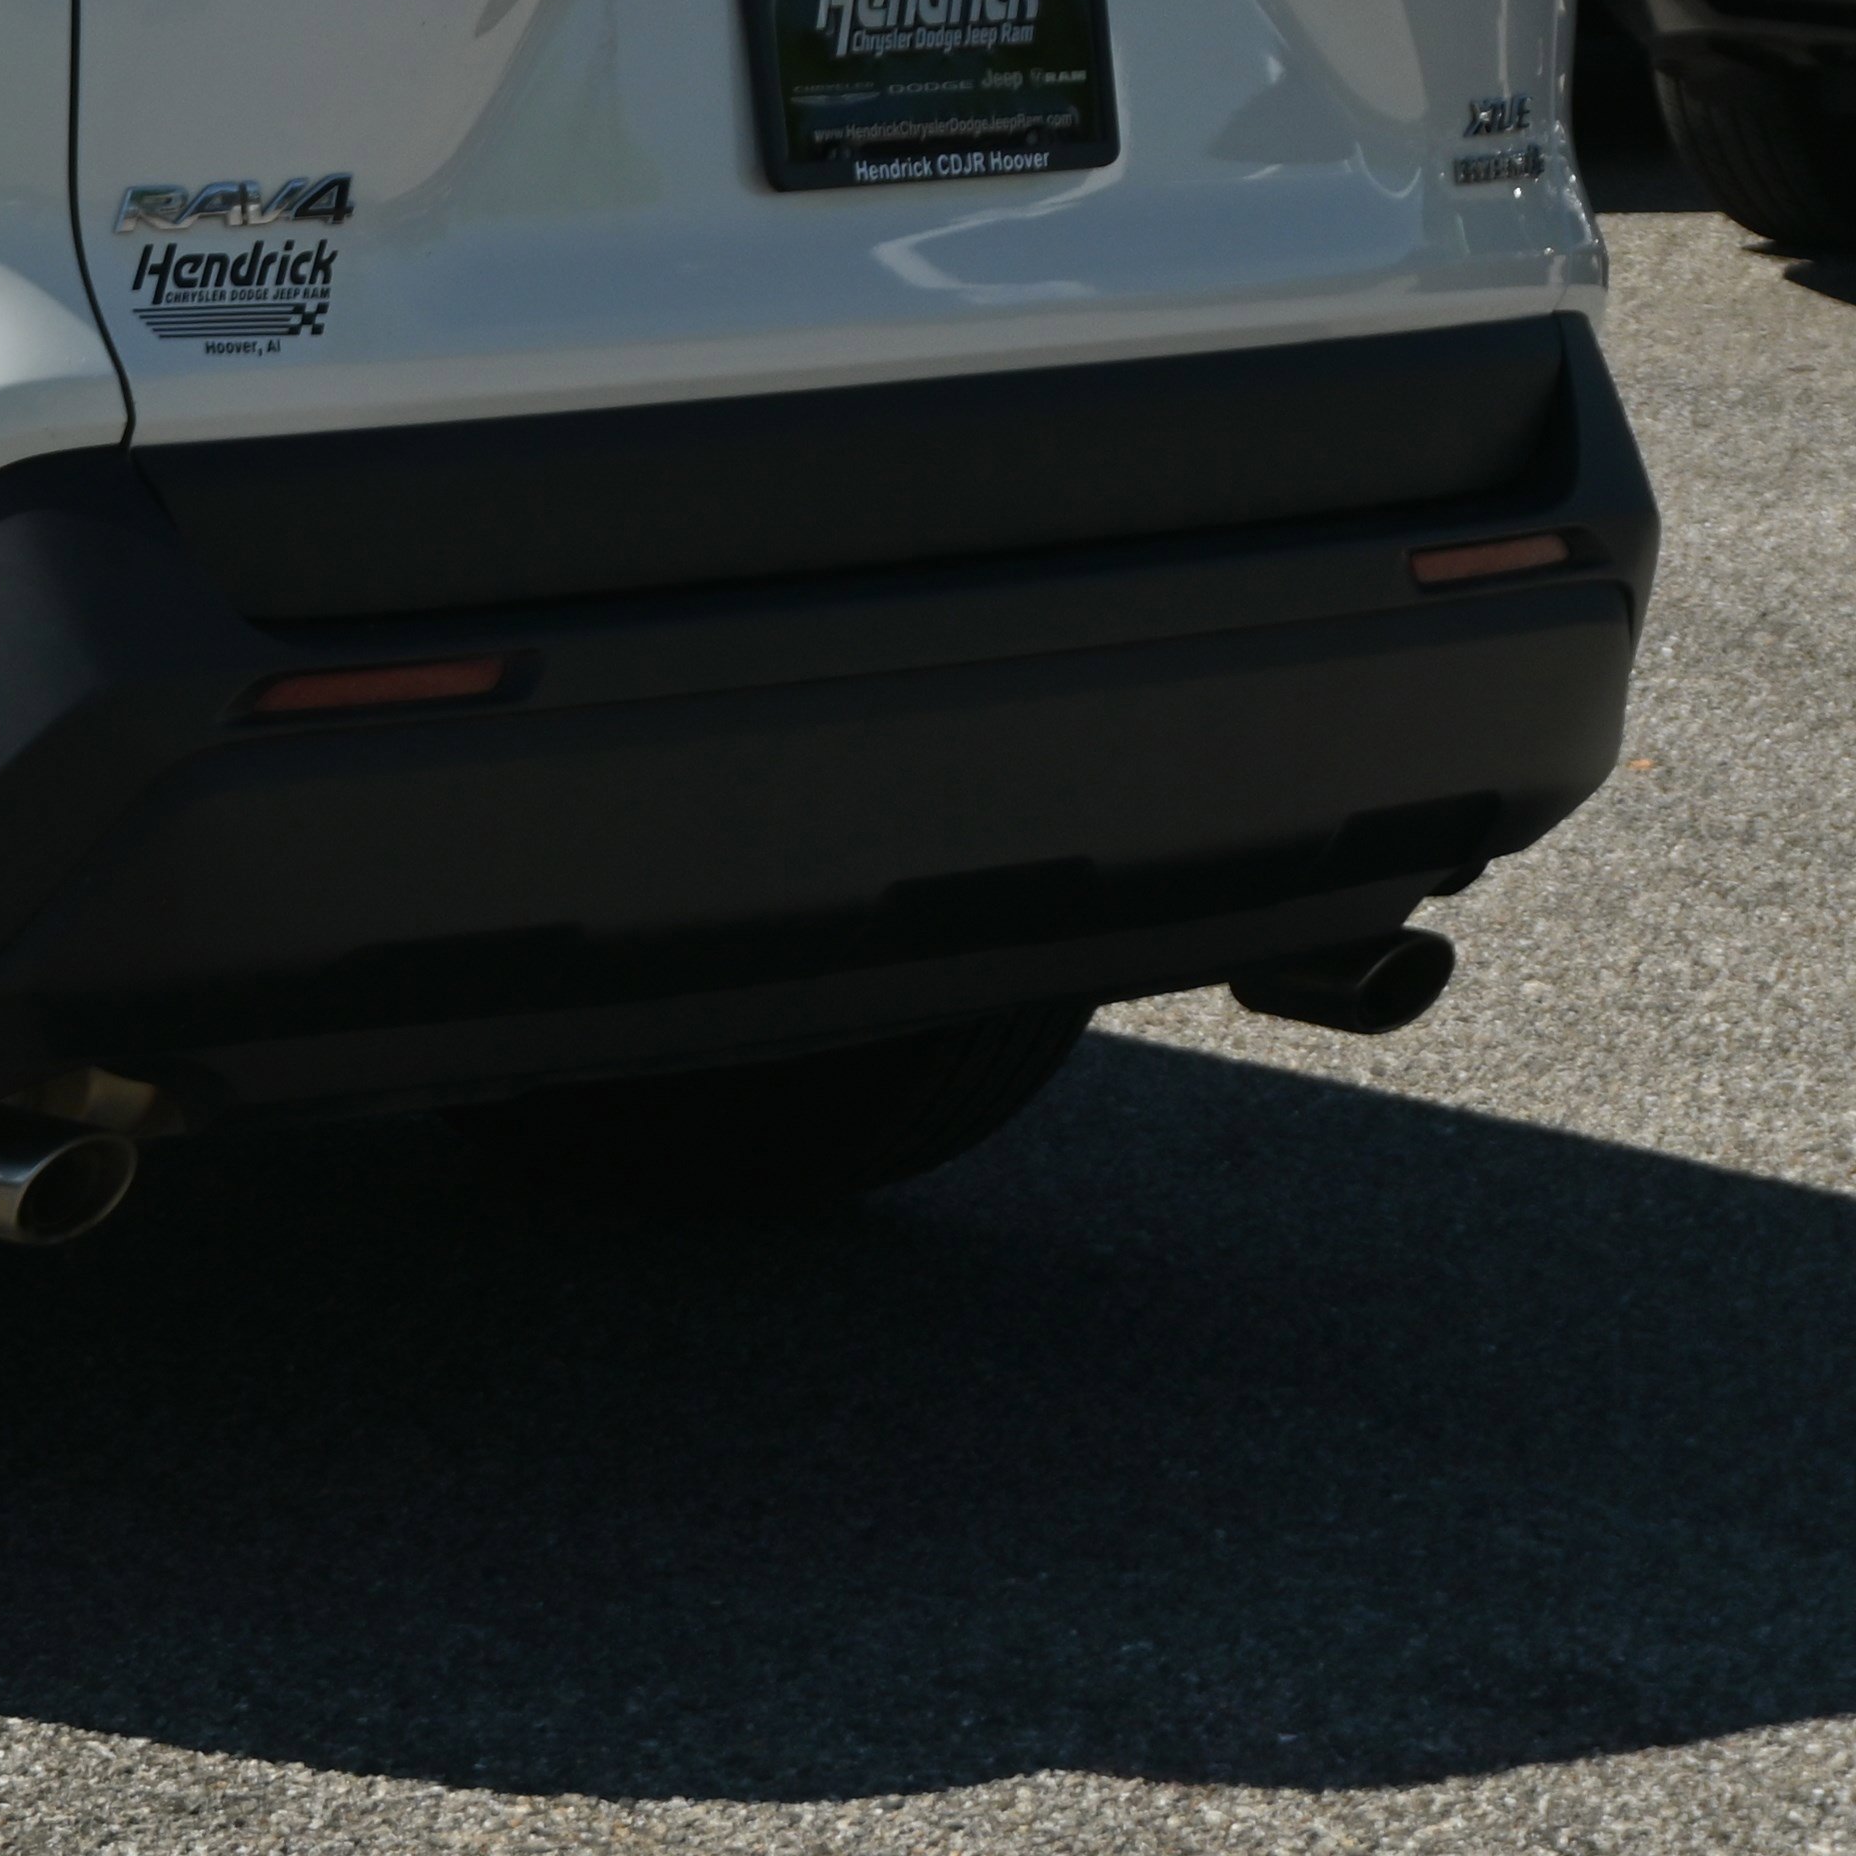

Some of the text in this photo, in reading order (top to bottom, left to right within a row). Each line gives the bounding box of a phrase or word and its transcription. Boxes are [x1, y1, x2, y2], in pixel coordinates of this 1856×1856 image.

[851, 22, 1036, 57] Chrysler Dodge Jeep Ram
[888, 78, 975, 95] DODGE
[981, 67, 1024, 90] Jeep
[1045, 69, 1088, 83] RAM
[854, 149, 1050, 182] Hendrick CDJR Hoover
[113, 171, 355, 233] RAV4
[132, 239, 338, 305] Hendrick
[165, 287, 331, 304] CHRYSLER DODGE JEEP RAM
[205, 340, 263, 357] Hoover,
